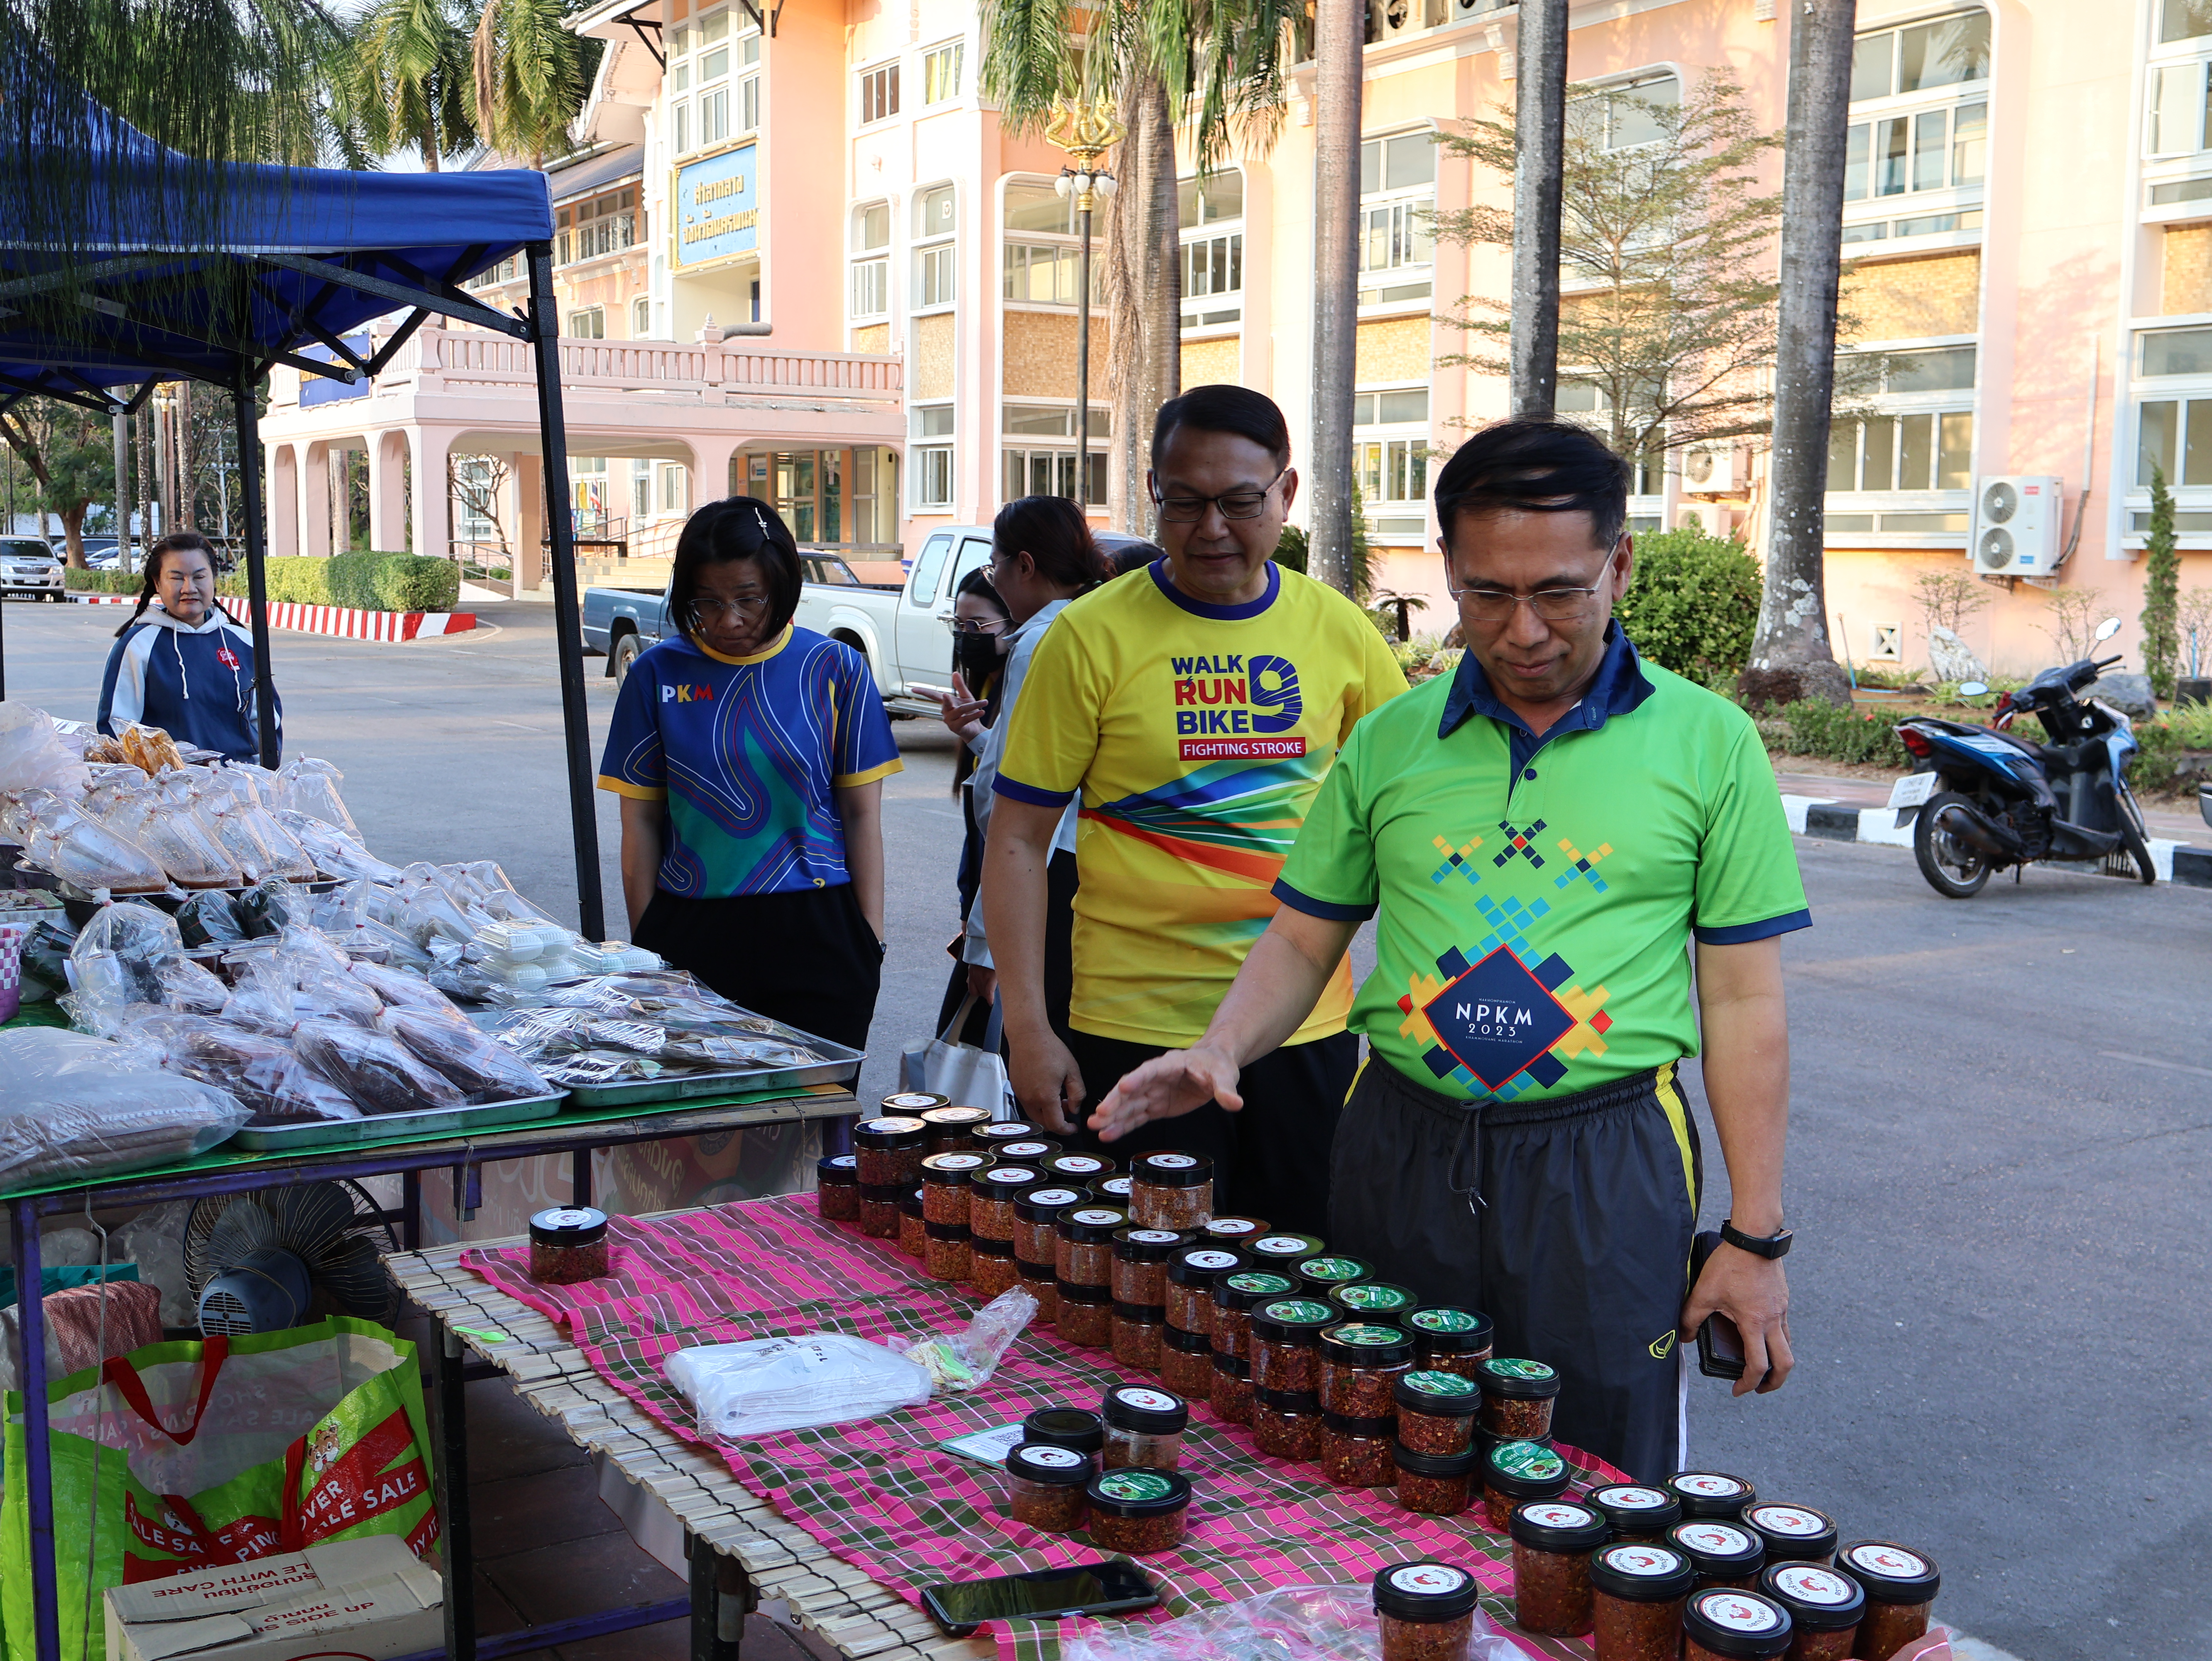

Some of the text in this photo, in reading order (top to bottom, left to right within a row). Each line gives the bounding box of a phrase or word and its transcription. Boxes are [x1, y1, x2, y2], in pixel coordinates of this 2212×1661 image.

[694, 174, 744, 205] ศาลากลาง
[1171, 654, 1244, 675] WALK
[1174, 678, 1246, 706] RUN
[1248, 654, 1303, 734] 9
[1176, 710, 1249, 735] BIKE
[1183, 742, 1302, 757] FIGHTING STROKE
[1456, 1002, 1532, 1026] NPKM
[1468, 1023, 1516, 1037] 2023
[362, 1470, 416, 1509] SALE
[1682, 1476, 1704, 1488] ปลาร้าบอง
[1607, 1493, 1629, 1507] ปลาร้าบอง
[1529, 1506, 1563, 1517] ปลาร้าบอง
[1796, 1512, 1815, 1531] ปลาร้าบอง
[1712, 1527, 1741, 1546] ปลาร้าบอง
[1650, 1551, 1669, 1570] ปลาร้าบอง
[1861, 1551, 1887, 1572] ปลาร้าบอง
[221, 1569, 278, 1586] WITH
[1400, 1572, 1420, 1590] ปลาร้าบอง
[1786, 1573, 1809, 1597] ปลาร้าบอง
[152, 1581, 215, 1597] CARE
[264, 1603, 330, 1622] ด้านบน
[286, 1610, 340, 1627] SIDE
[344, 1602, 374, 1612] UP
[1746, 1608, 1768, 1628] ปลาร้าบอง
